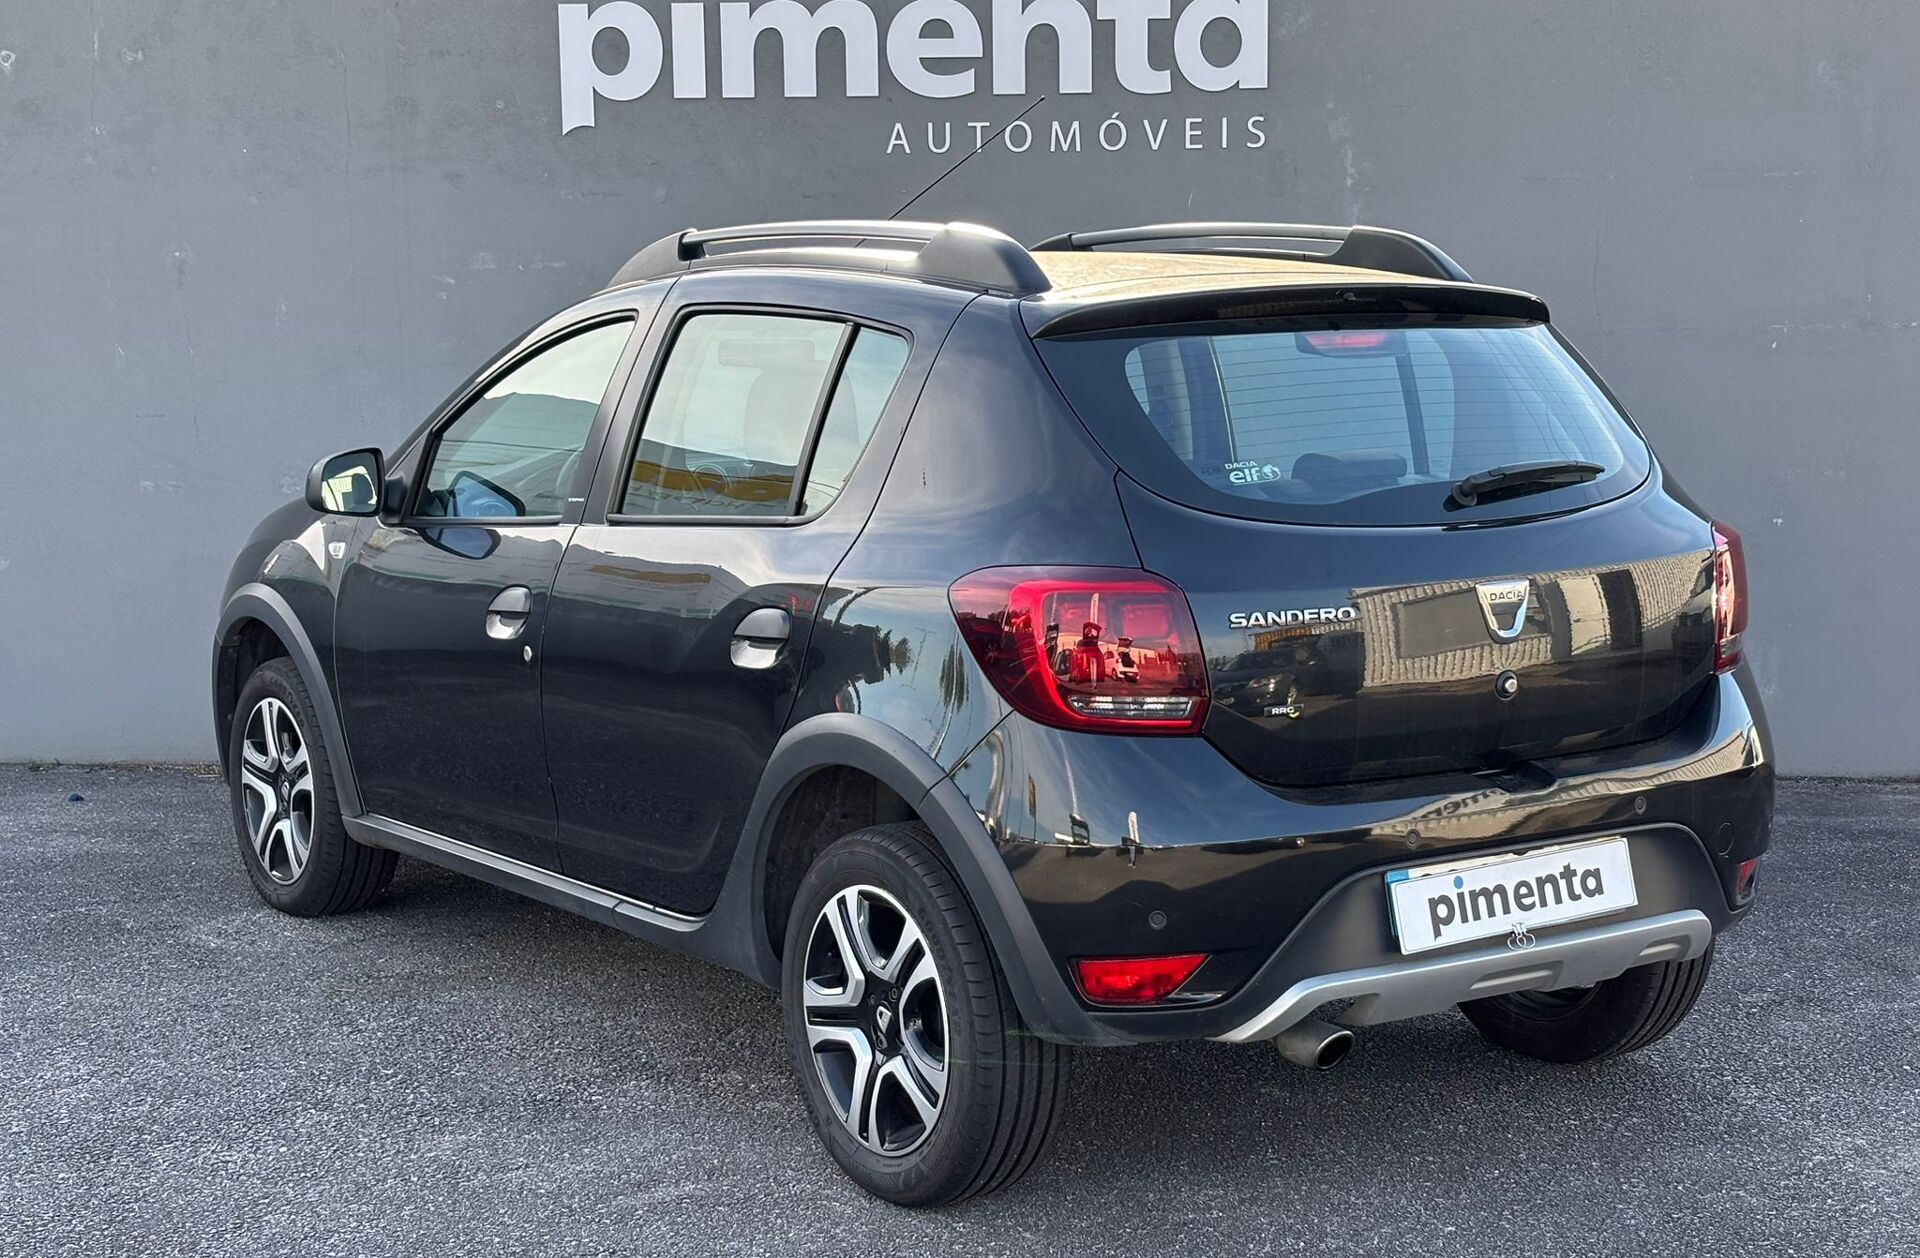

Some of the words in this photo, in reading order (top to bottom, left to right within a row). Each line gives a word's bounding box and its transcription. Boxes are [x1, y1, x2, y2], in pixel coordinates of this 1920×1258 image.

[559, 0, 1269, 135] pimenta
[886, 112, 1267, 154] AUTOMÓVEIS
[1225, 461, 1257, 470] DACIA
[1229, 467, 1260, 483] elf
[1489, 590, 1525, 601] DACIA
[1229, 606, 1356, 629] SANDERO
[1427, 861, 1605, 942] pimenta
